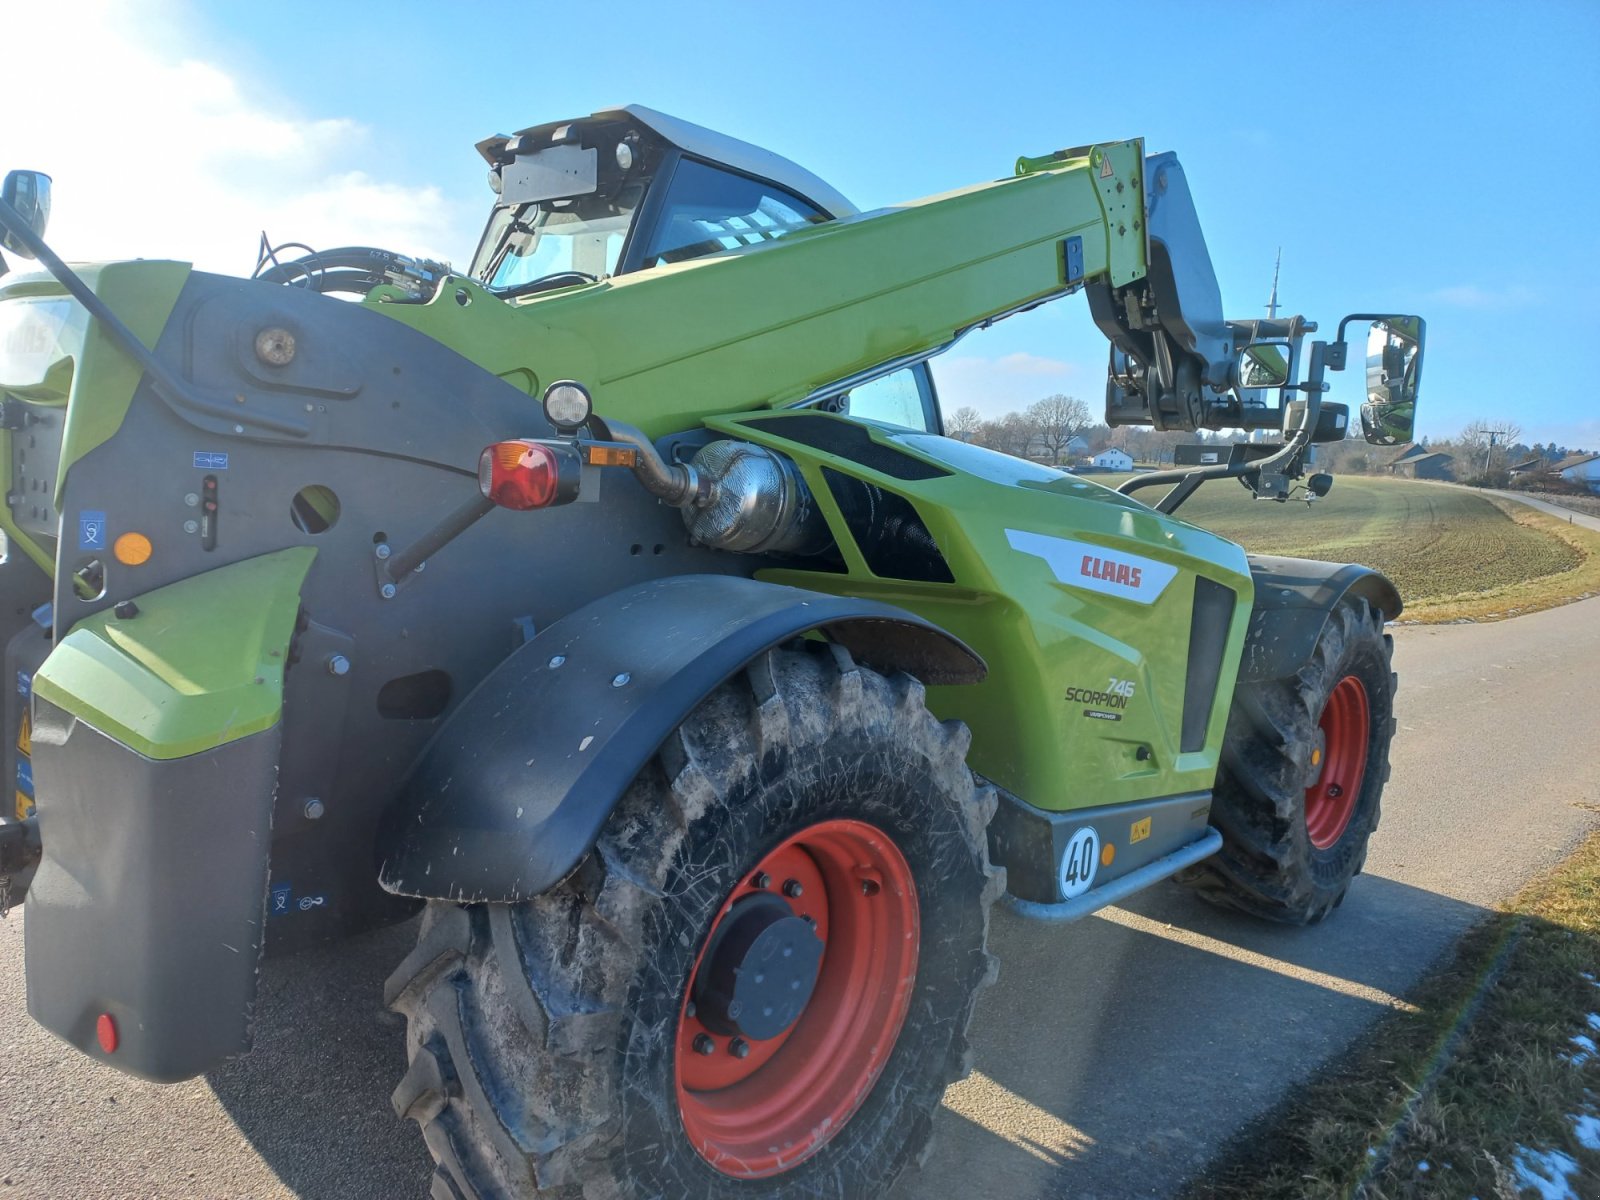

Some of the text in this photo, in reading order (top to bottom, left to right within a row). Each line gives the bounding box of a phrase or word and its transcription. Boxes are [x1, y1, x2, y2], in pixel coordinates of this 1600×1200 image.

[1081, 555, 1142, 588] CLAAS
[1065, 687, 1128, 708] SCORPION
[1106, 678, 1135, 697] 746
[1065, 836, 1094, 886] 40
